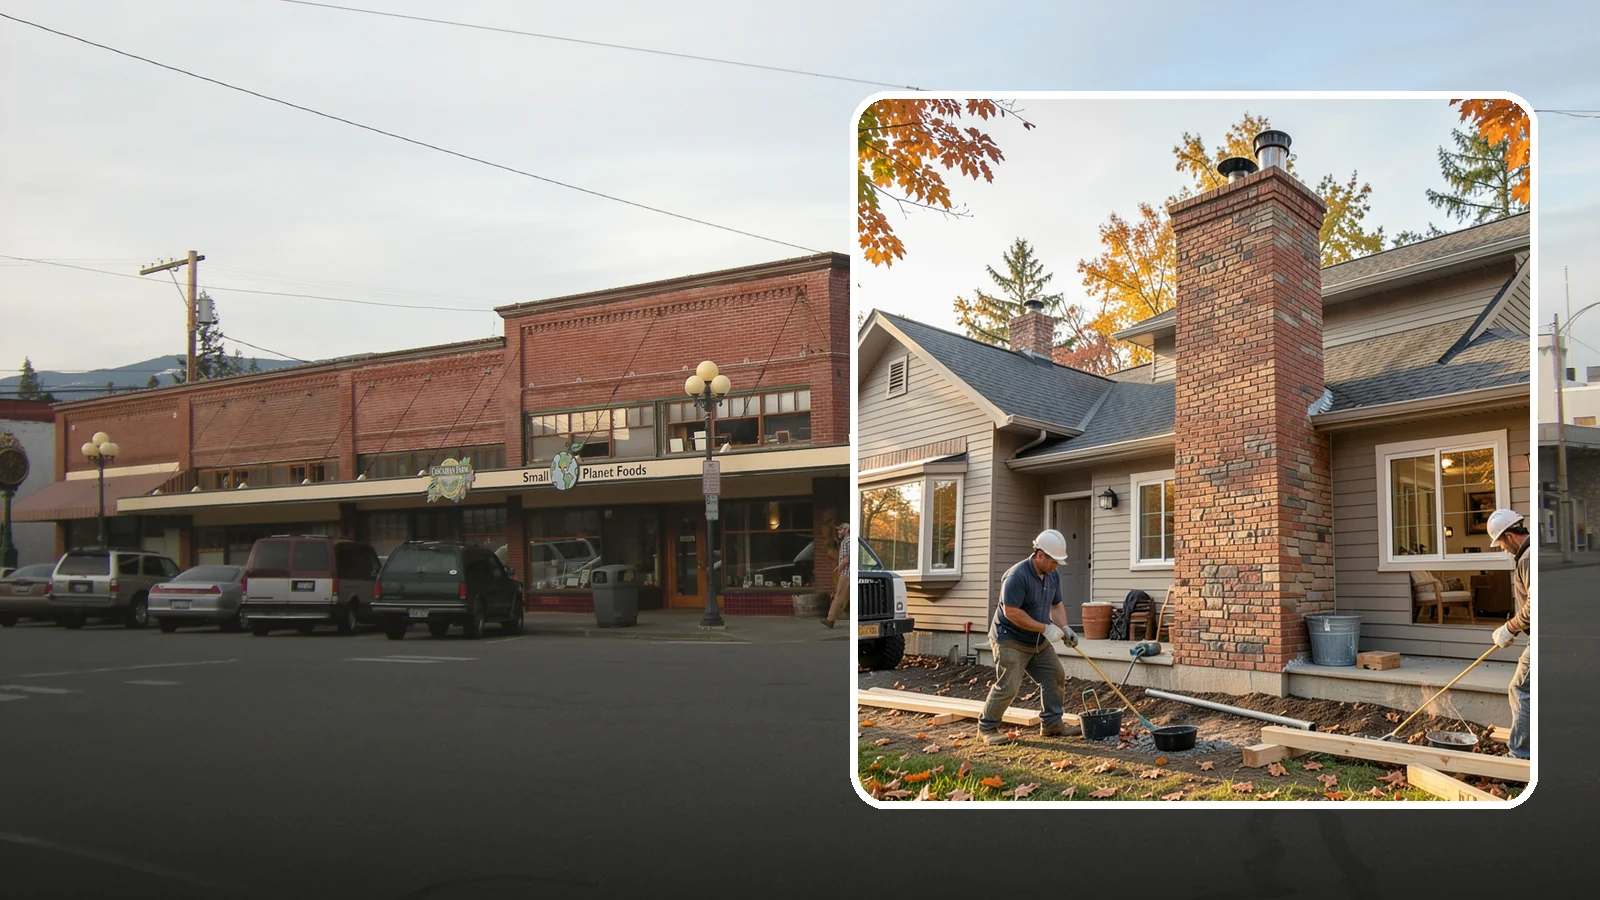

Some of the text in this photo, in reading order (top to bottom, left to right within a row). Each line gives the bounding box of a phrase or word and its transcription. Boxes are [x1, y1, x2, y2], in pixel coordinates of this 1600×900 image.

[523, 464, 647, 483] Small Planet Foods
